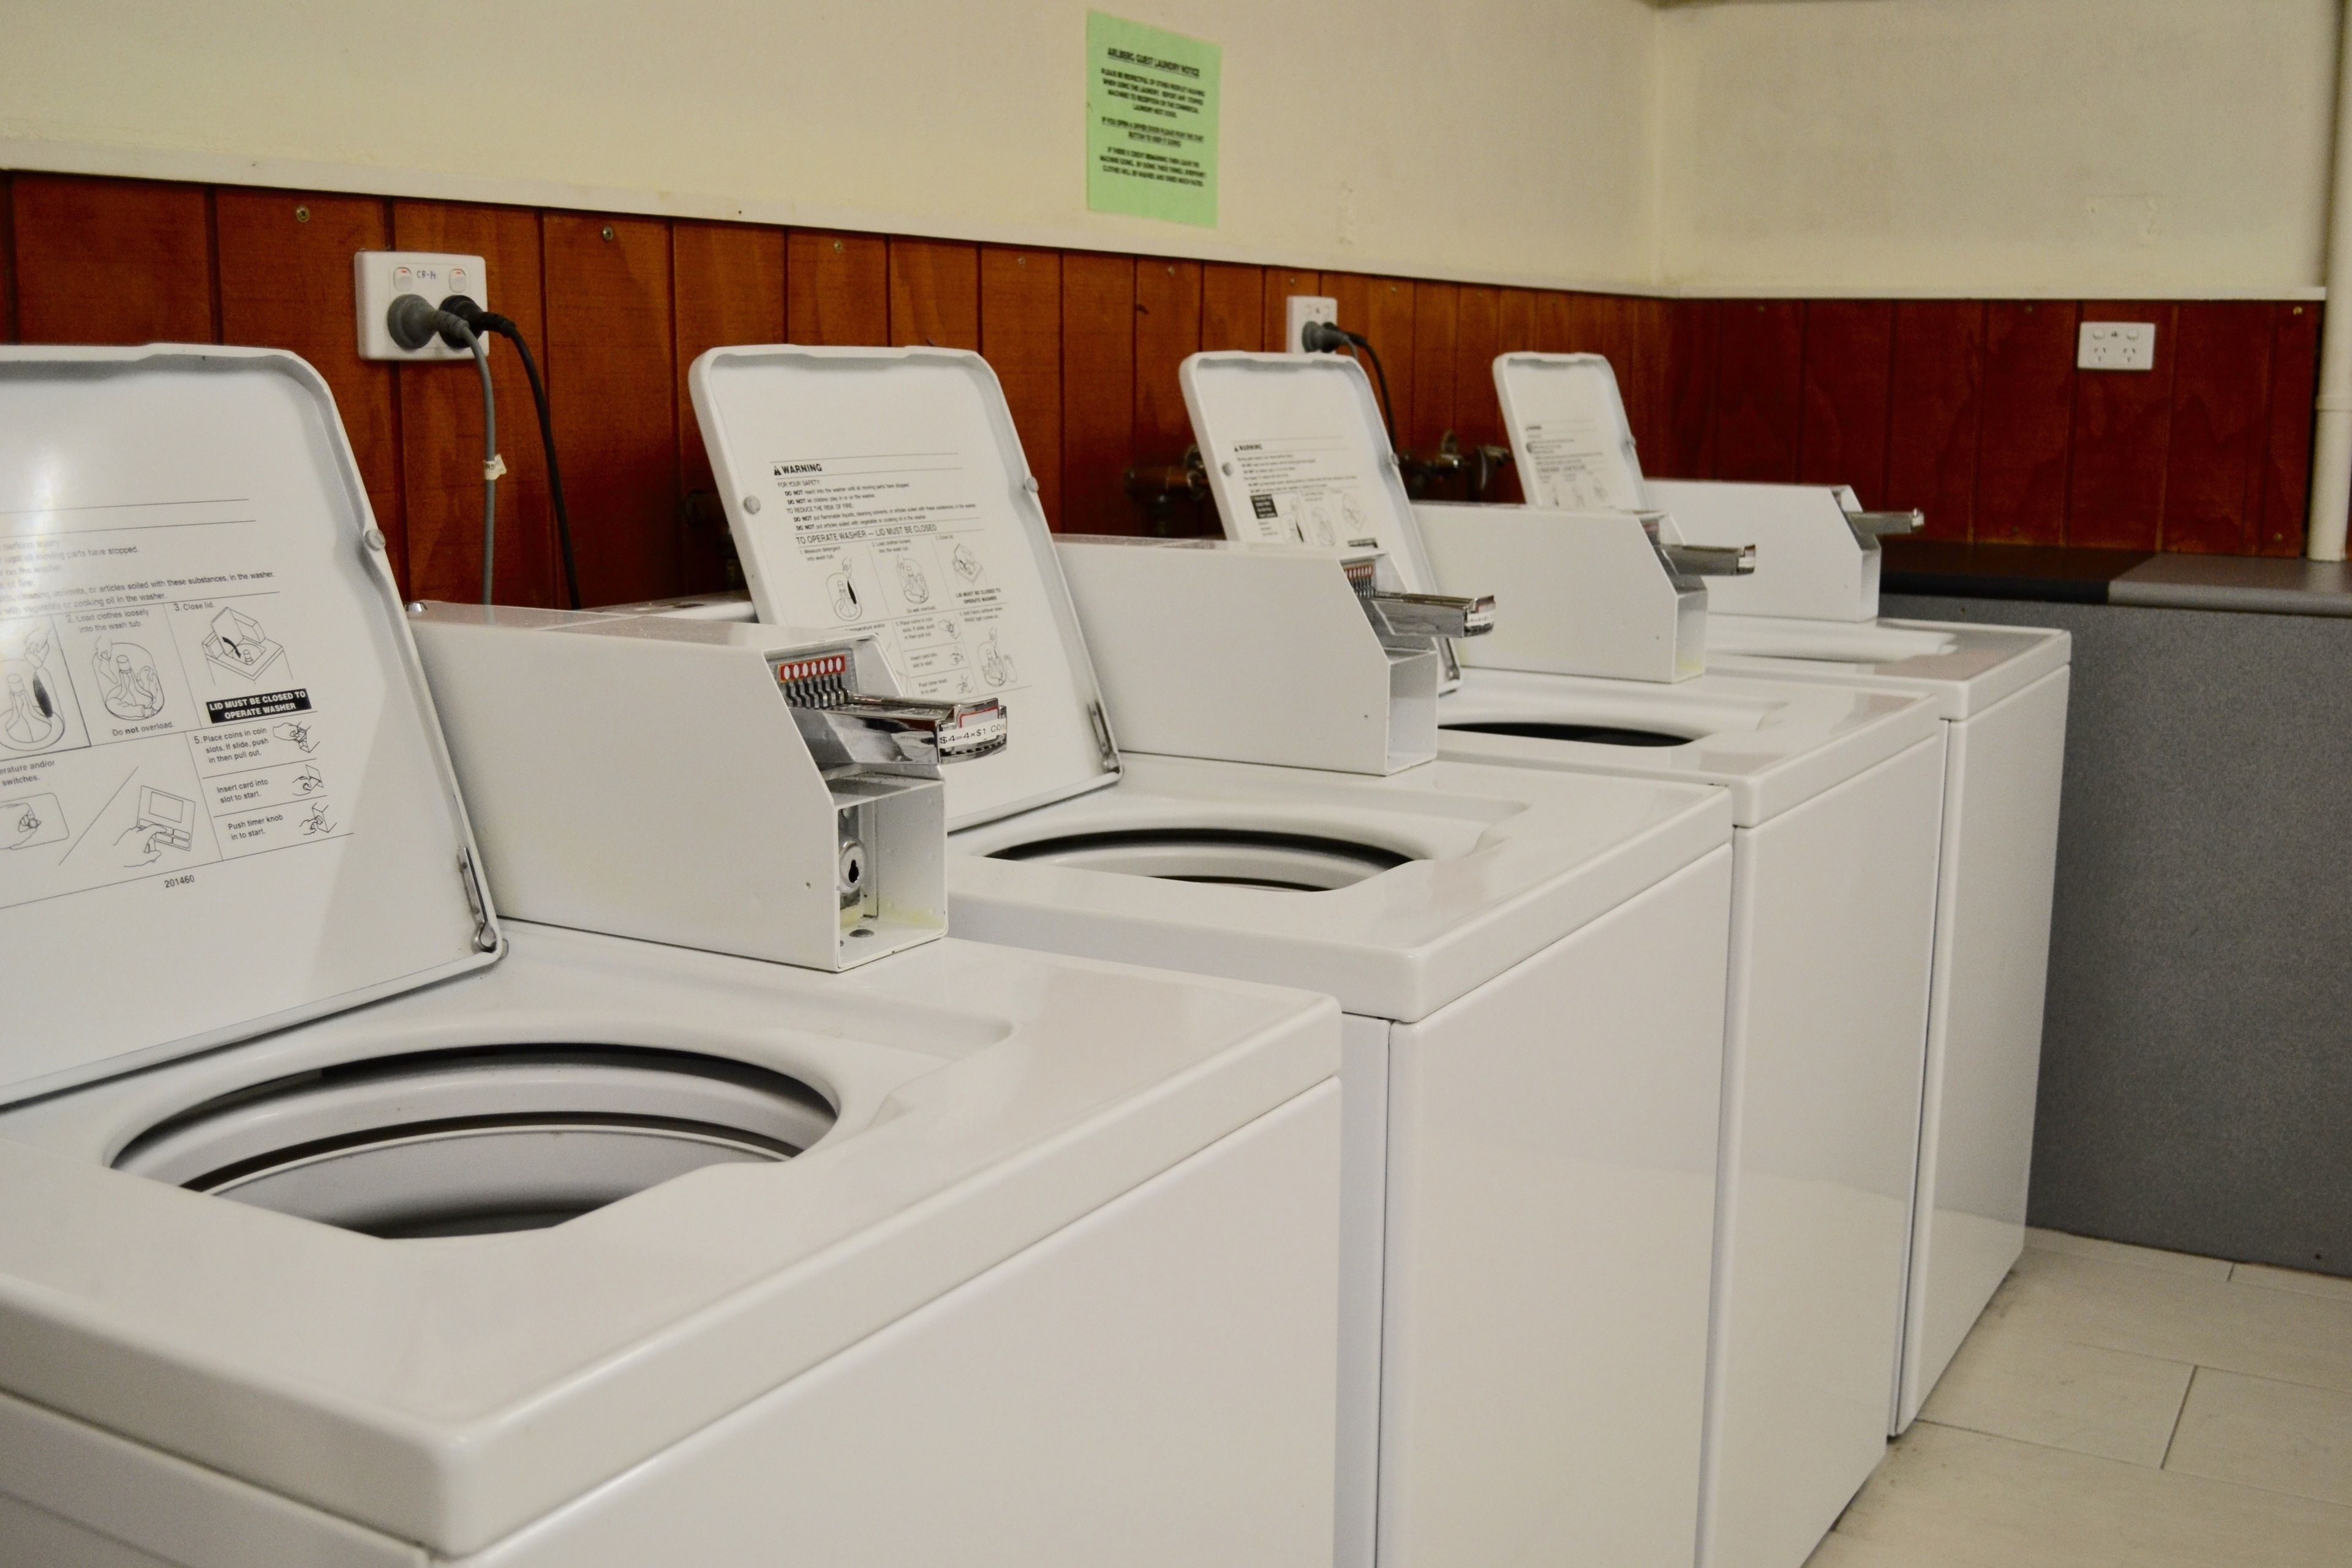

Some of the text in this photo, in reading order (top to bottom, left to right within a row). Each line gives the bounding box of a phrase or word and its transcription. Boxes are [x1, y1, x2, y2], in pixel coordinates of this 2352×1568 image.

[782, 463, 823, 474] WARNING
[807, 533, 837, 543] OPERATE
[839, 530, 867, 541] WASHER
[914, 524, 937, 533] CLOSED
[67, 550, 86, 560] parts
[108, 546, 138, 556] stopped.
[99, 584, 126, 593] articles
[127, 581, 149, 590] soiled
[74, 596, 104, 608] cooking
[77, 614, 96, 622] Load
[97, 612, 123, 621] clothes
[124, 609, 149, 618] loosely
[94, 624, 107, 632] the
[110, 622, 126, 631] wash
[209, 702, 224, 711] LID
[224, 699, 247, 709] MUST
[250, 696, 261, 705] BE
[262, 692, 293, 704] CLOSED
[224, 703, 296, 720] OPERATE WASHER
[141, 722, 175, 732] overload.
[252, 737, 270, 747] push
[217, 754, 233, 763] then
[235, 752, 247, 761] pull
[30, 760, 55, 770] and/or
[266, 814, 284, 823] knob
[164, 875, 195, 888] 201460
